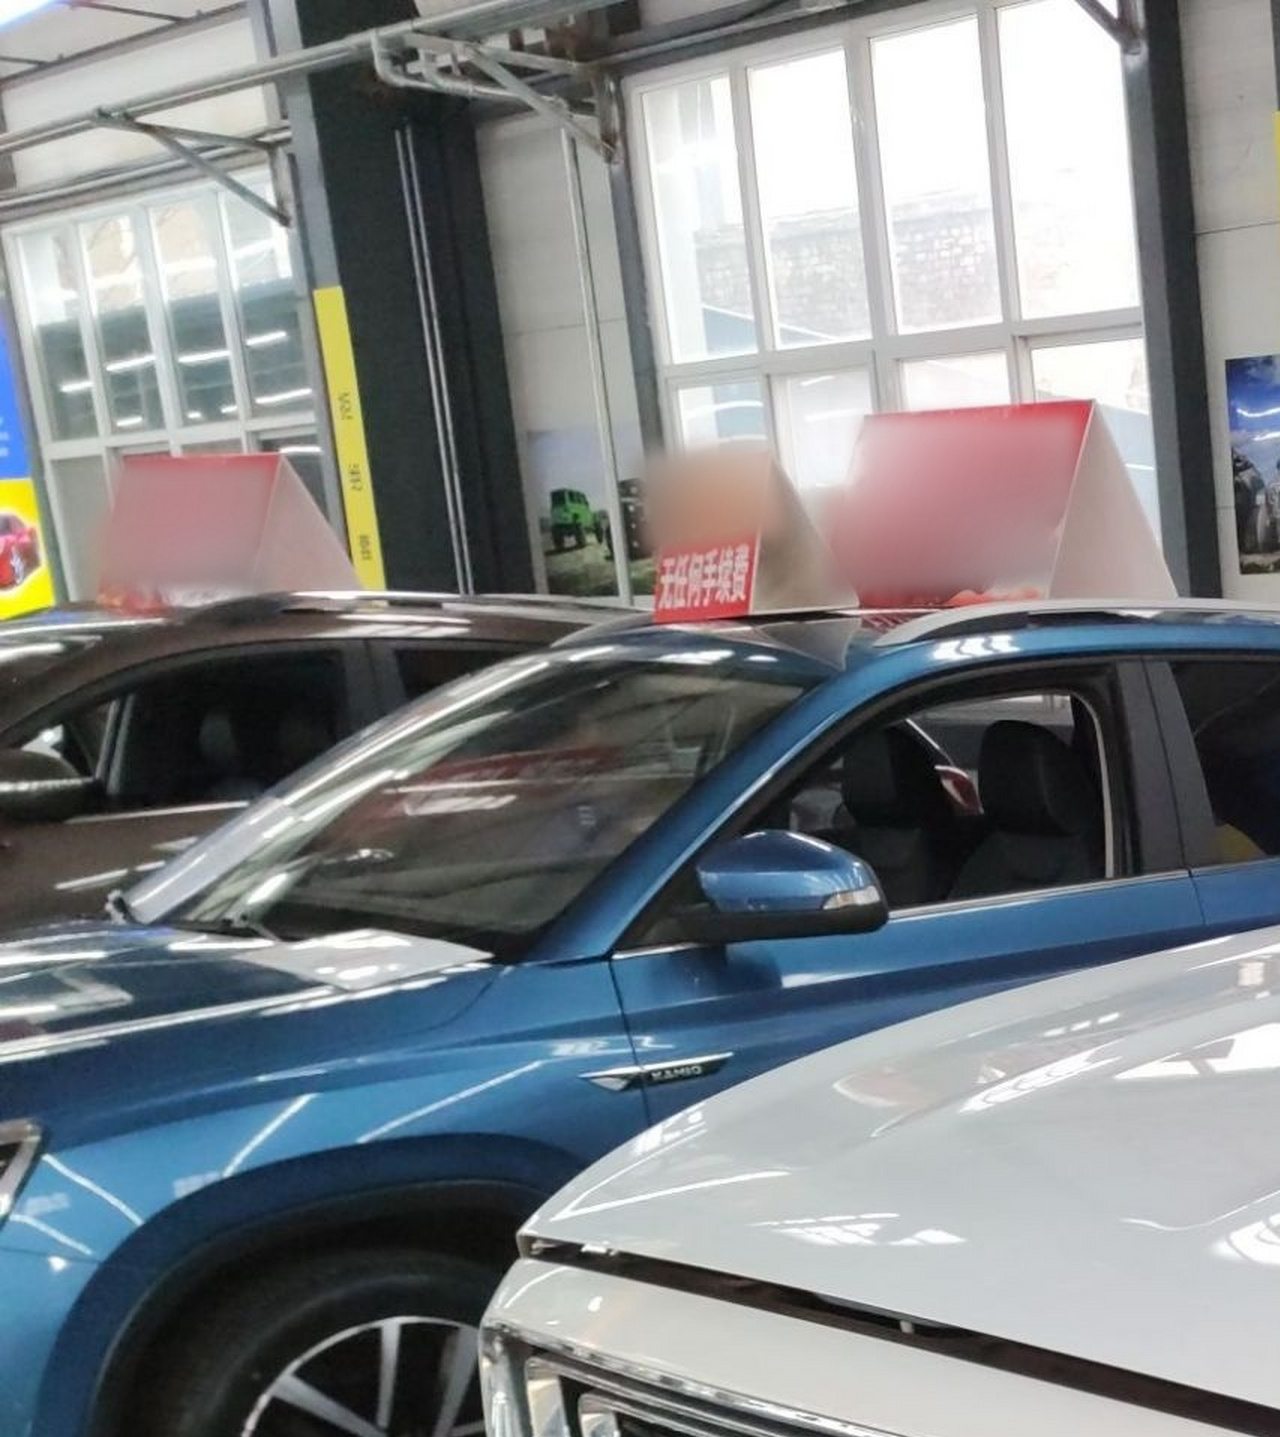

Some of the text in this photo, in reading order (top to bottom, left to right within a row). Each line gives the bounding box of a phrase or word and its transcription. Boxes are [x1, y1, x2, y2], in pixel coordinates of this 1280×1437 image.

[659, 543, 749, 610] 无任何手续费
